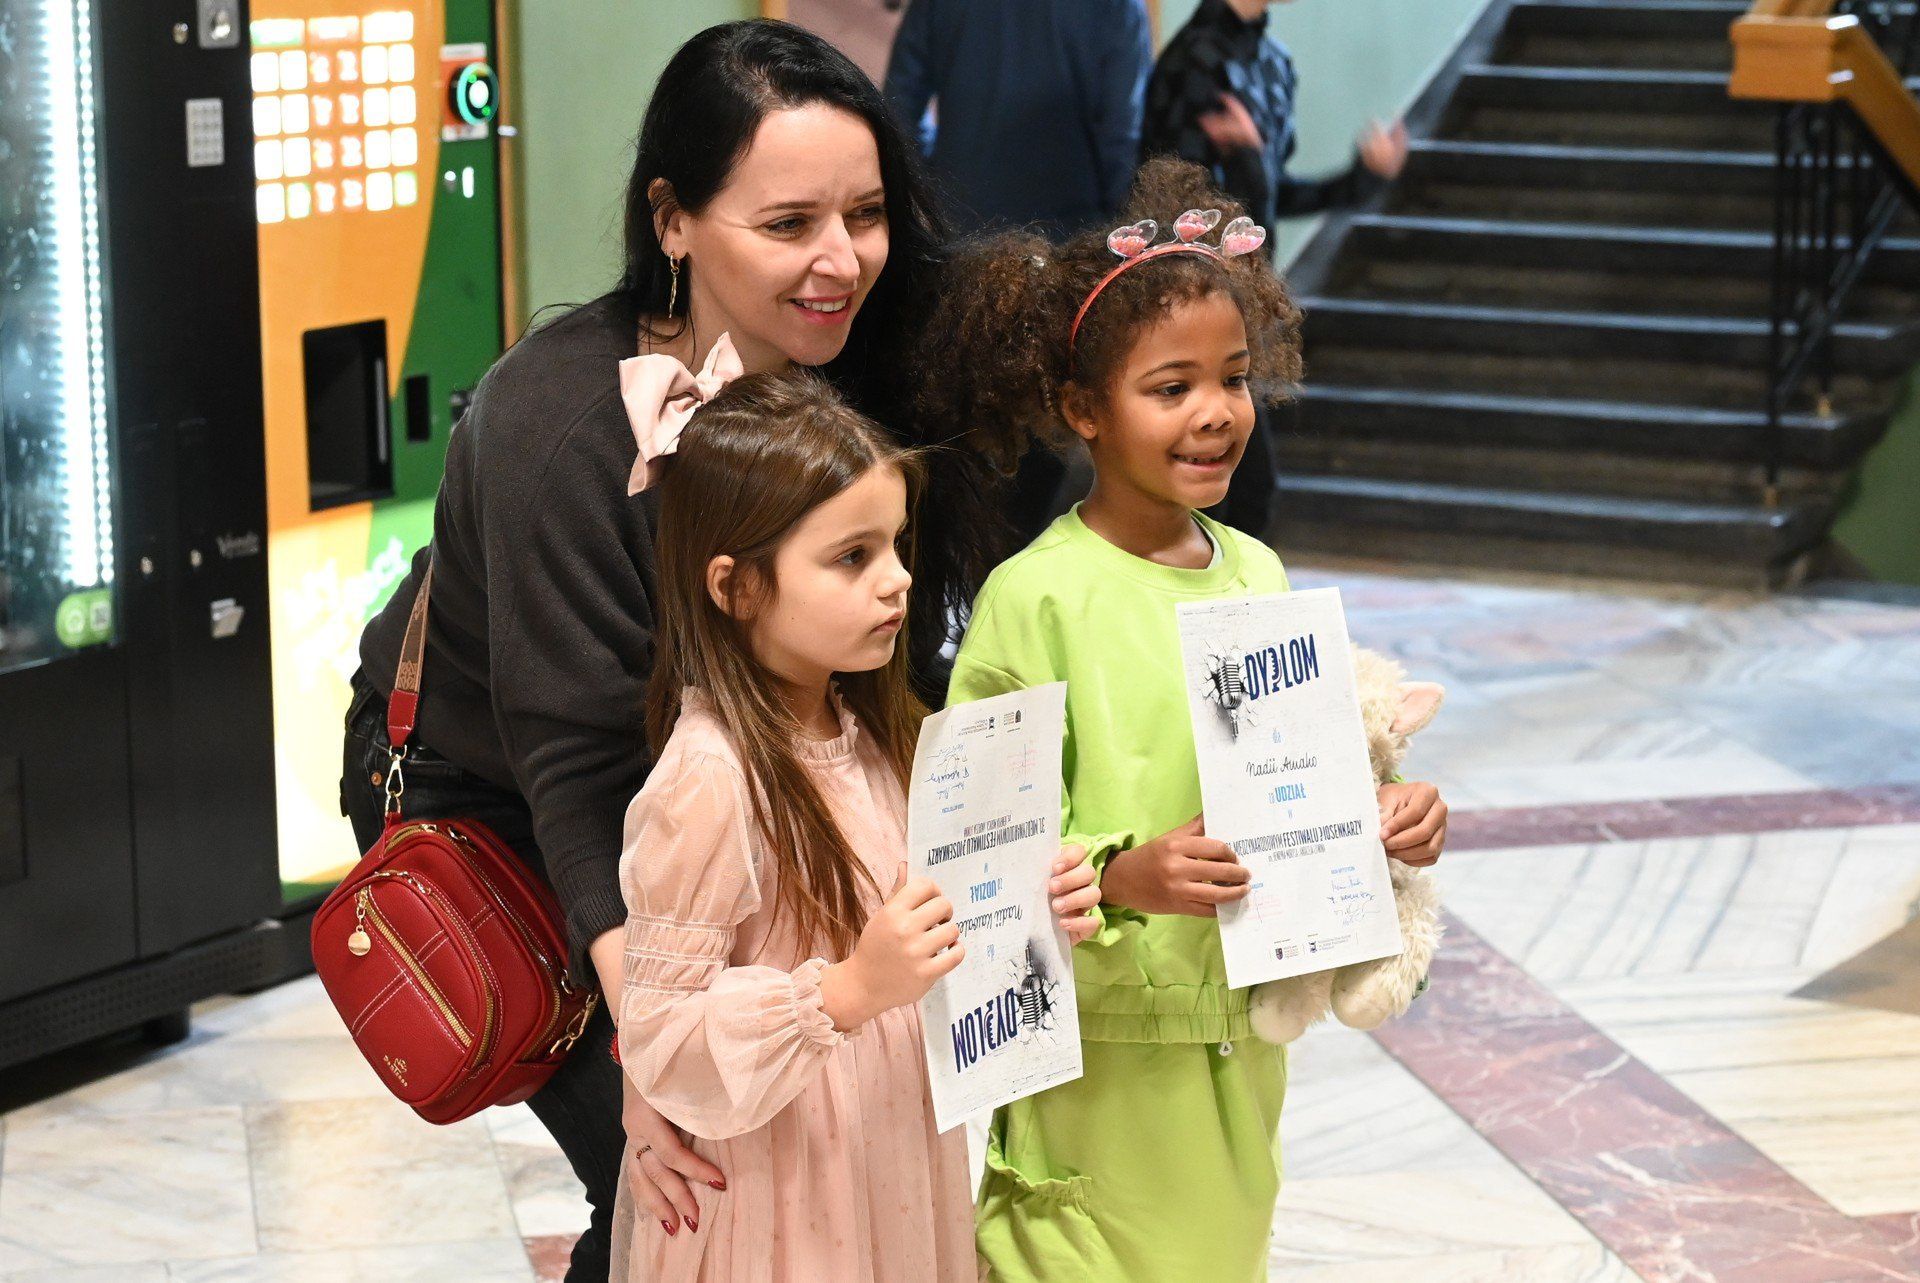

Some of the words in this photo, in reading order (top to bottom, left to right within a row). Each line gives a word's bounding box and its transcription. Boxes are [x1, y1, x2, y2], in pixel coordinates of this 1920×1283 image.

[1275, 783, 1306, 802] UDZIAŁ
[966, 829, 997, 854] FESTIWALU
[1283, 826, 1319, 848] FESTIWALU
[970, 880, 997, 903] UDZIAŁ
